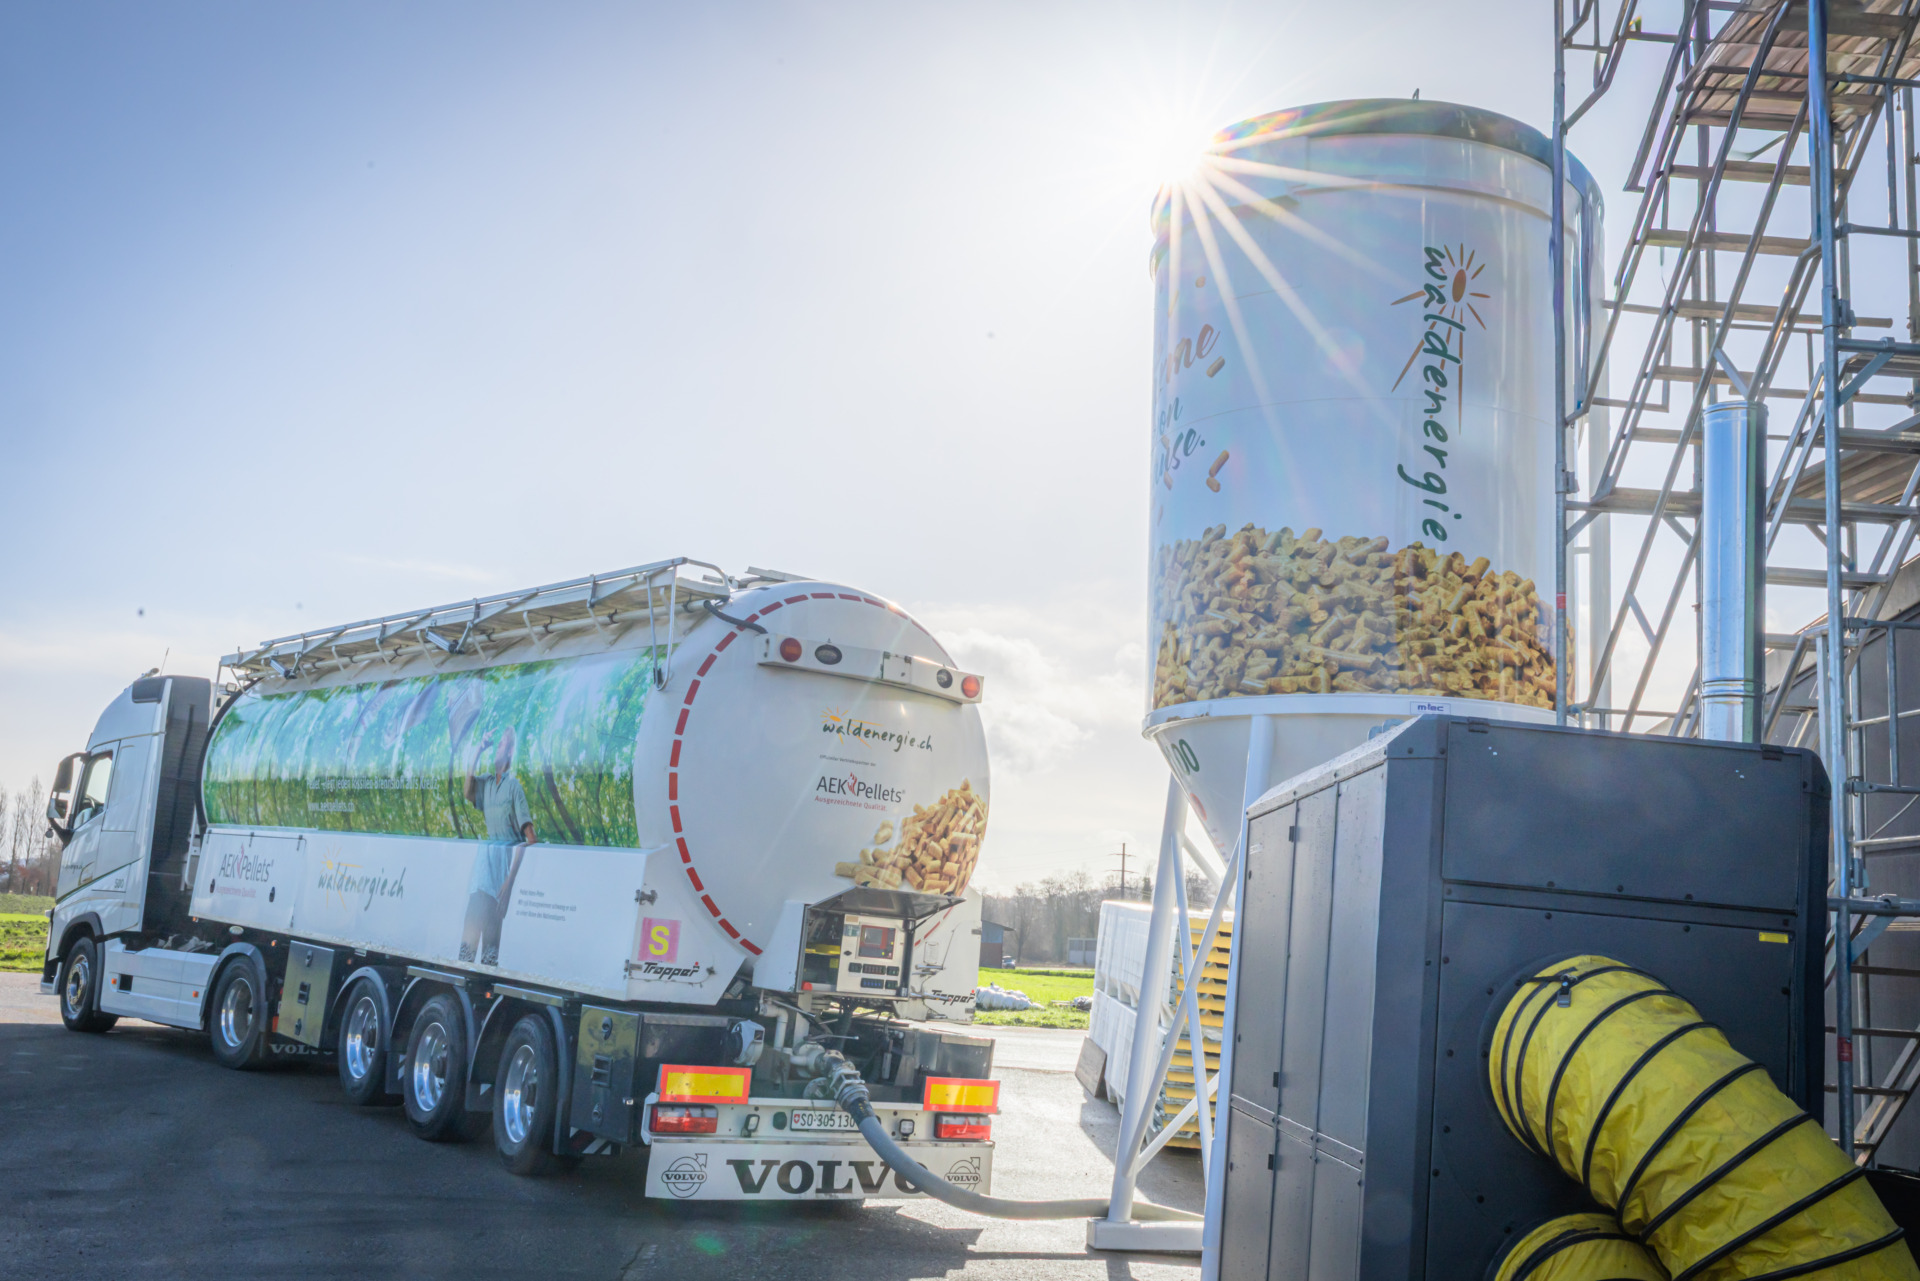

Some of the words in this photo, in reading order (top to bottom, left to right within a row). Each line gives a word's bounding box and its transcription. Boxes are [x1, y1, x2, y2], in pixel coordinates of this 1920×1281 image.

[1397, 246, 1466, 542] waldenergie
[822, 718, 933, 752] waldenergie.ch
[816, 776, 847, 795] AEK
[856, 781, 902, 803] Pellets
[218, 853, 239, 878] AEK
[239, 855, 271, 882] Pellets
[318, 861, 406, 912] waldenergie.ch
[648, 925, 670, 956] S
[269, 1043, 334, 1055] VOL
[664, 1173, 705, 1181] VOLVO
